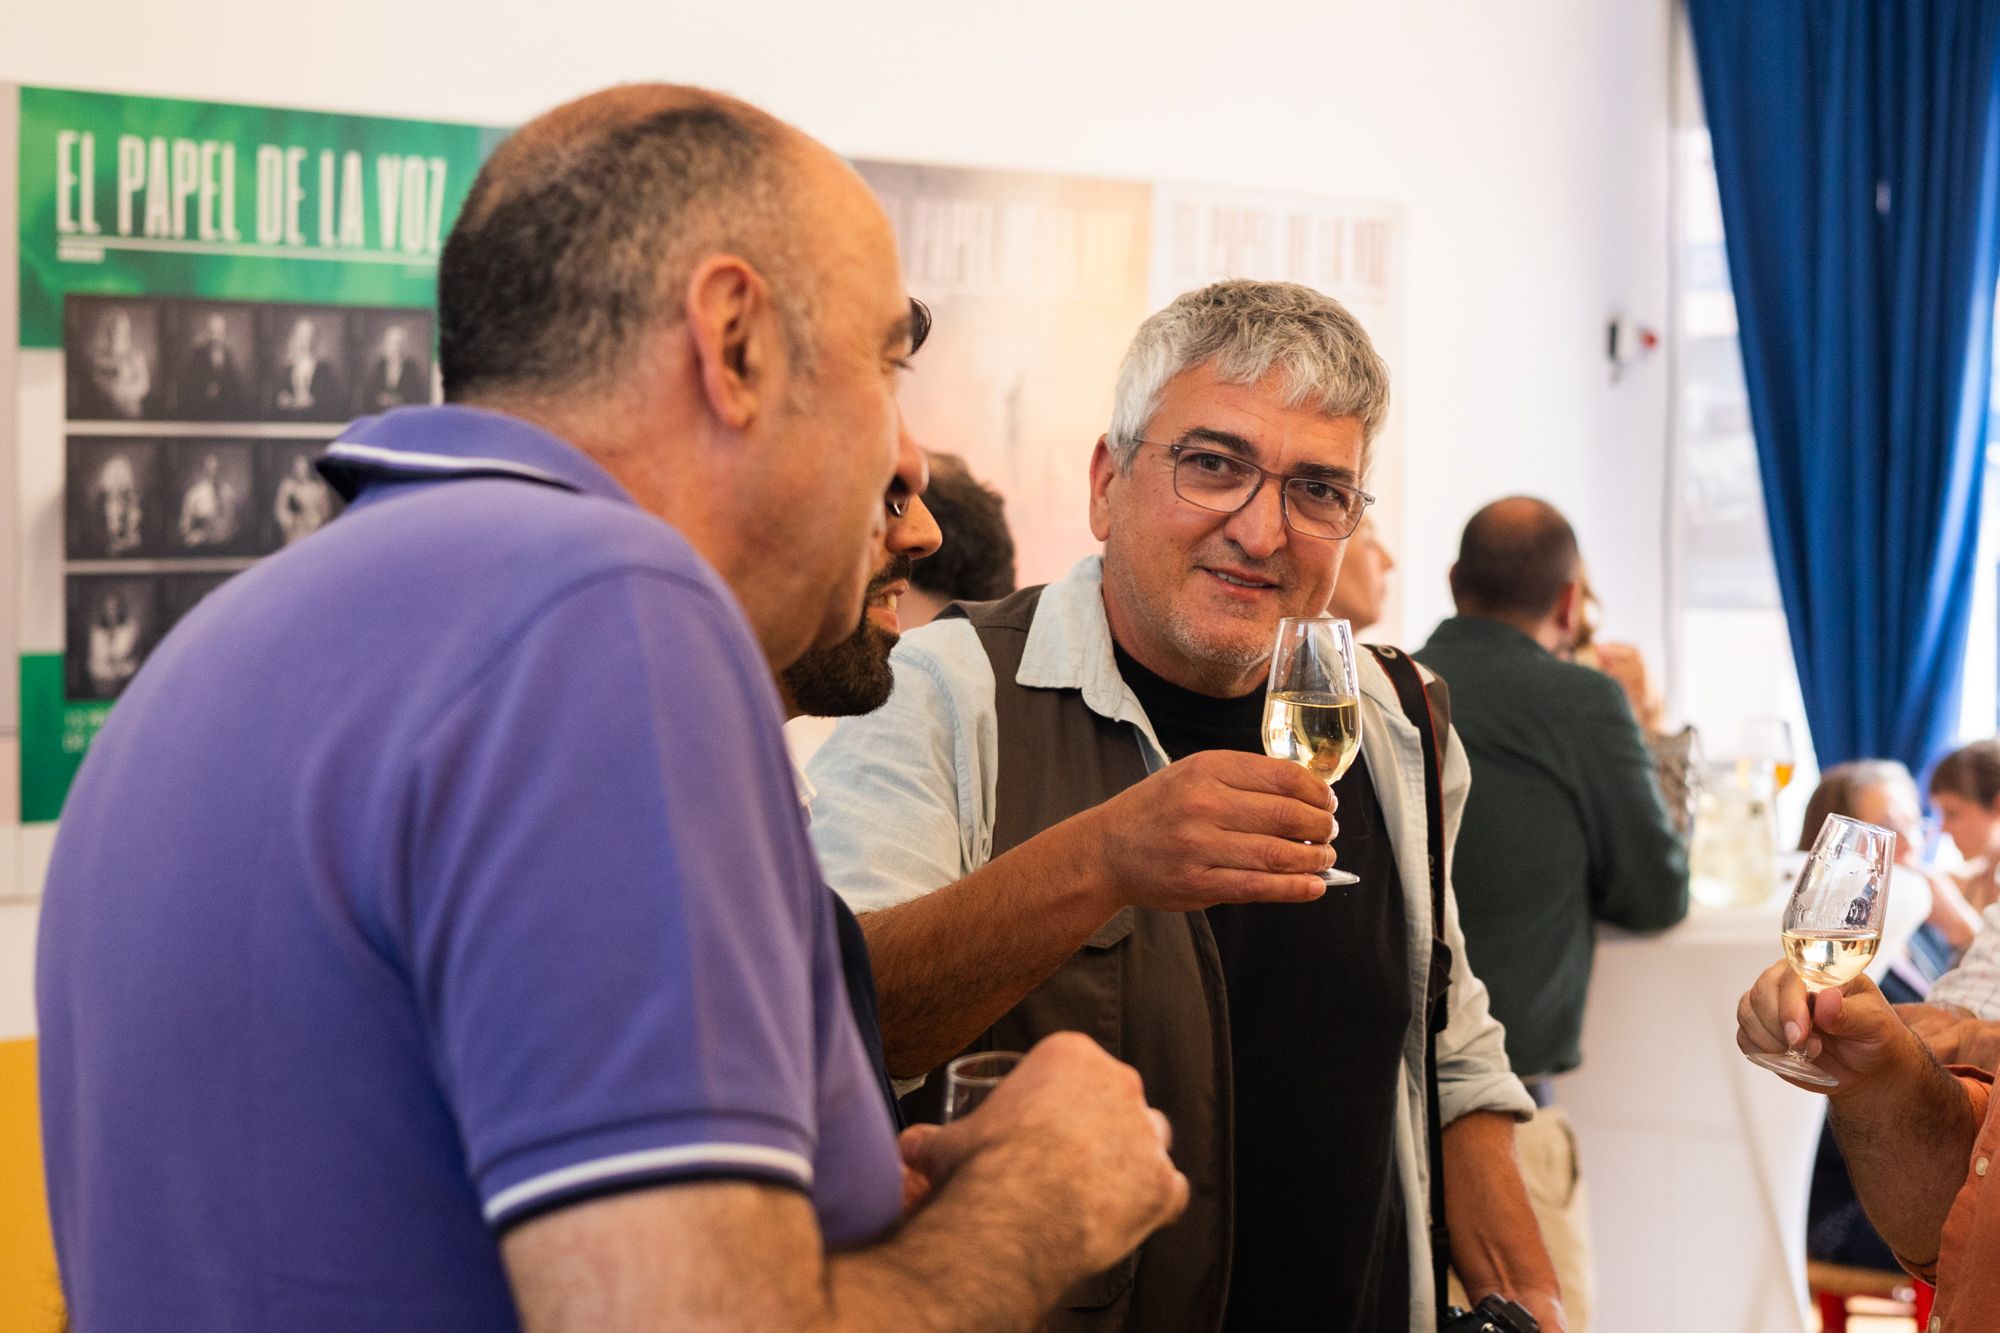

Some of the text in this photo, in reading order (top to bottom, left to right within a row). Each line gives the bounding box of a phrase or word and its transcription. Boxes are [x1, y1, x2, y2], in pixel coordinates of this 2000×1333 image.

[56, 130, 447, 253] EL PAPEL DE LA VOZ
